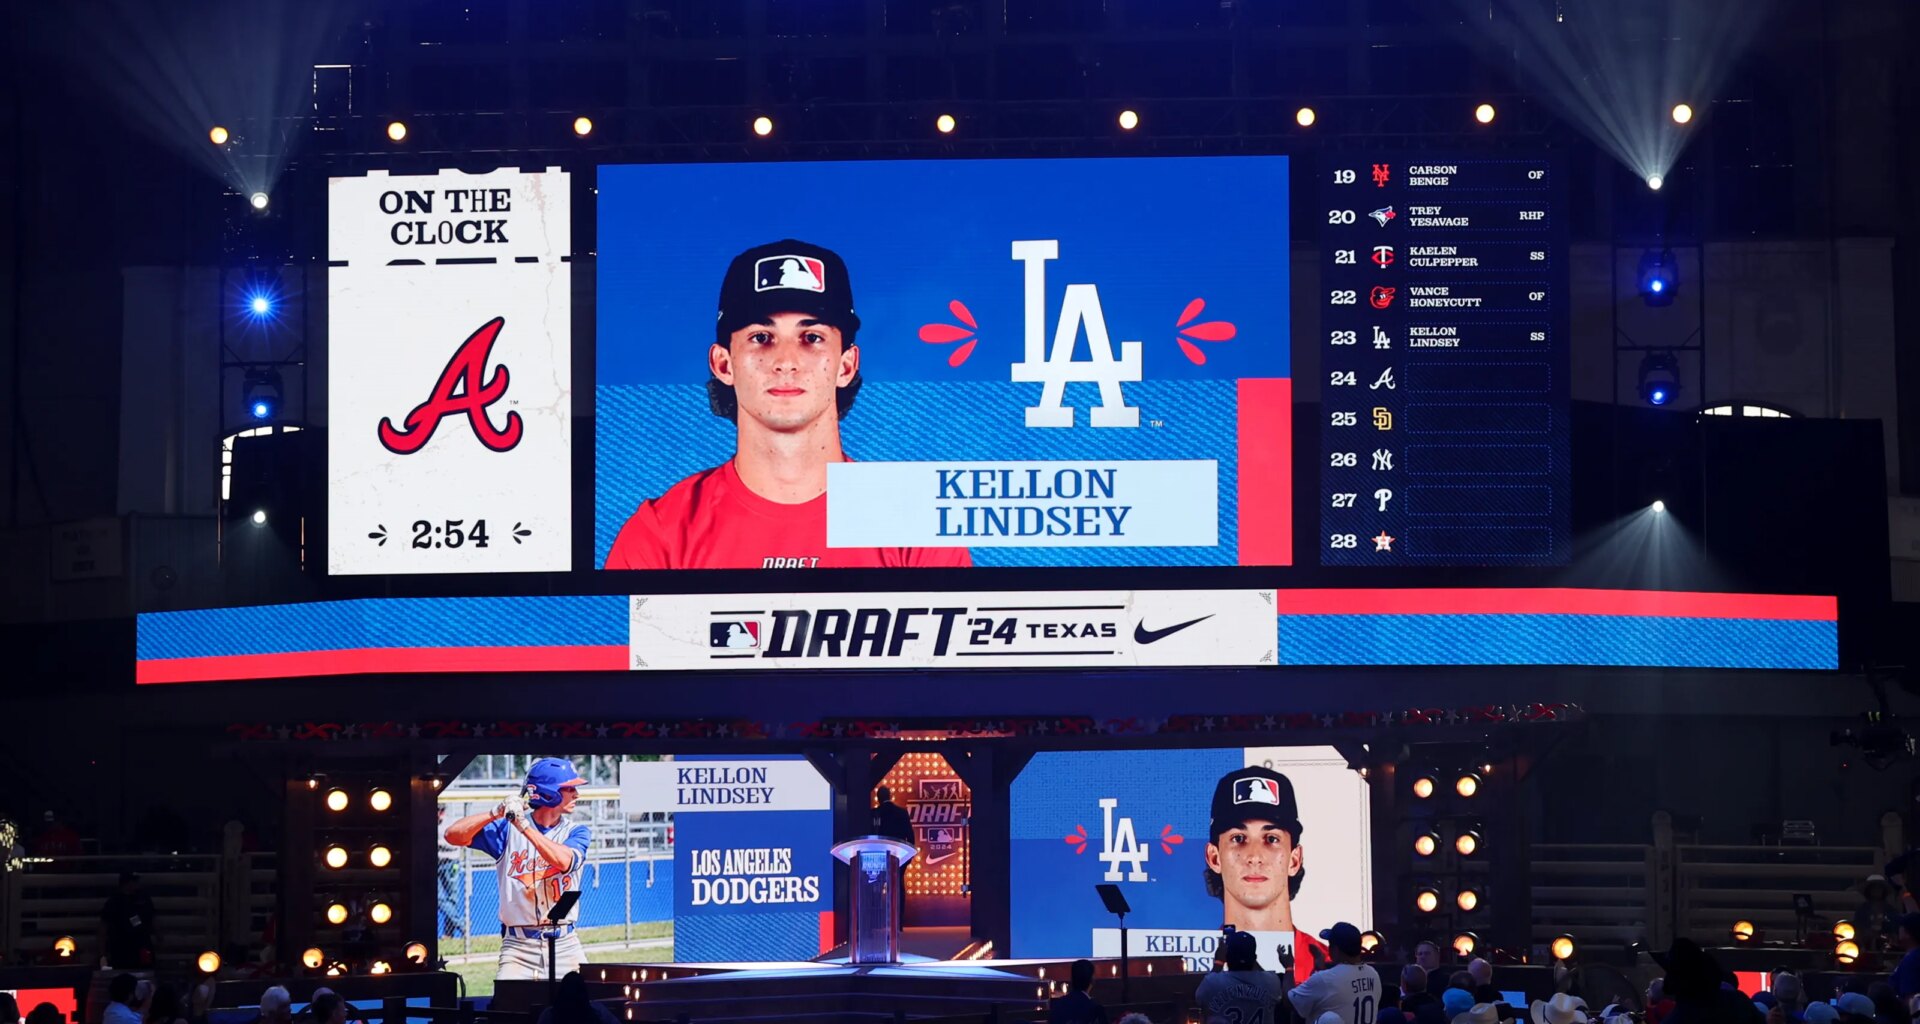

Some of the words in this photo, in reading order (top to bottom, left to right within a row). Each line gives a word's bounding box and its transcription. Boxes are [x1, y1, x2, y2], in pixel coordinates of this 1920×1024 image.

[1333, 169, 1356, 184] 19
[1408, 165, 1458, 175] CARSON
[1527, 170, 1545, 180] OF
[1409, 176, 1449, 186] BENGE
[380, 190, 435, 214] ON
[445, 189, 511, 213] THE
[1328, 209, 1356, 225] 20
[1409, 206, 1442, 216] TREY
[1519, 210, 1545, 221] RHP
[1409, 217, 1469, 227] YESAVAGE
[391, 220, 508, 245] CLOCK
[1334, 249, 1357, 265] 21
[1409, 246, 1457, 256] KAELEN
[1529, 251, 1545, 261] SS
[1409, 257, 1479, 267] CULPEPPER
[1330, 289, 1357, 305] 22
[1409, 286, 1449, 296] VANCE
[1528, 291, 1545, 301] OF
[1409, 297, 1482, 308] HONEYCUTT
[1011, 240, 1142, 427] LA
[1330, 330, 1357, 346] 23
[1372, 325, 1391, 350] LA
[1409, 326, 1457, 336] KELLON
[1530, 331, 1545, 341] SS
[1409, 337, 1461, 348] LINDSEY
[378, 316, 523, 455] A
[1330, 370, 1357, 386] 24
[1369, 366, 1396, 390] A
[1331, 411, 1357, 427] 25
[1330, 452, 1358, 467] 26
[936, 469, 1117, 499] KELLON
[1331, 492, 1358, 508] 27
[1373, 488, 1393, 512] P
[936, 506, 1132, 536] LINDSEY
[412, 520, 489, 549] 2:54
[1330, 533, 1358, 549] 28
[762, 608, 967, 657] DRAFT
[1026, 623, 1117, 639] TEXAS
[677, 767, 767, 785] KELLON
[677, 787, 774, 805] LINDSEY
[1099, 798, 1148, 882] LA
[691, 849, 720, 876] LOS
[723, 847, 792, 875] ANGELES
[691, 876, 820, 906] DODGERS
[1145, 935, 1223, 953] KELLO
[1351, 977, 1374, 994] STEIN
[1353, 995, 1374, 1024] 10
